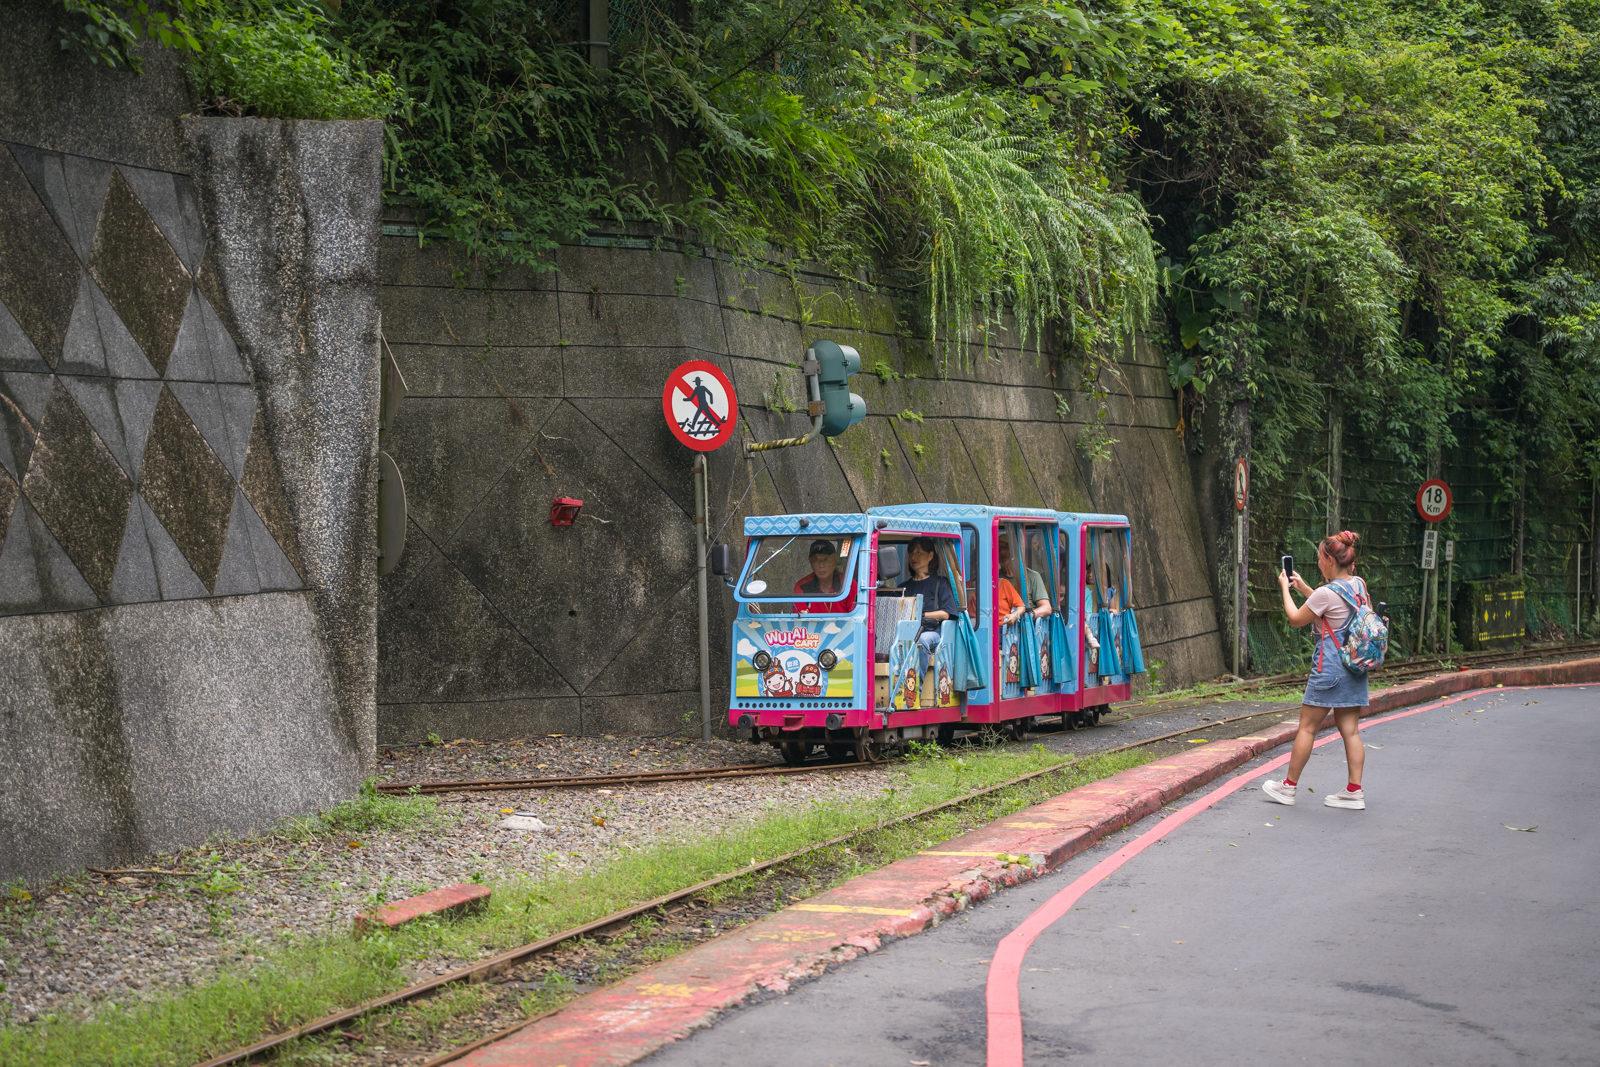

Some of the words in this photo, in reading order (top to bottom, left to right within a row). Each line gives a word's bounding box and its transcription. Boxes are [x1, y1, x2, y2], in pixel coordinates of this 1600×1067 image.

[1426, 487, 1442, 504] 18
[1427, 504, 1440, 513] Km
[1424, 531, 1435, 568] 最高速限
[764, 627, 807, 646] WULAI
[794, 639, 819, 648] CART
